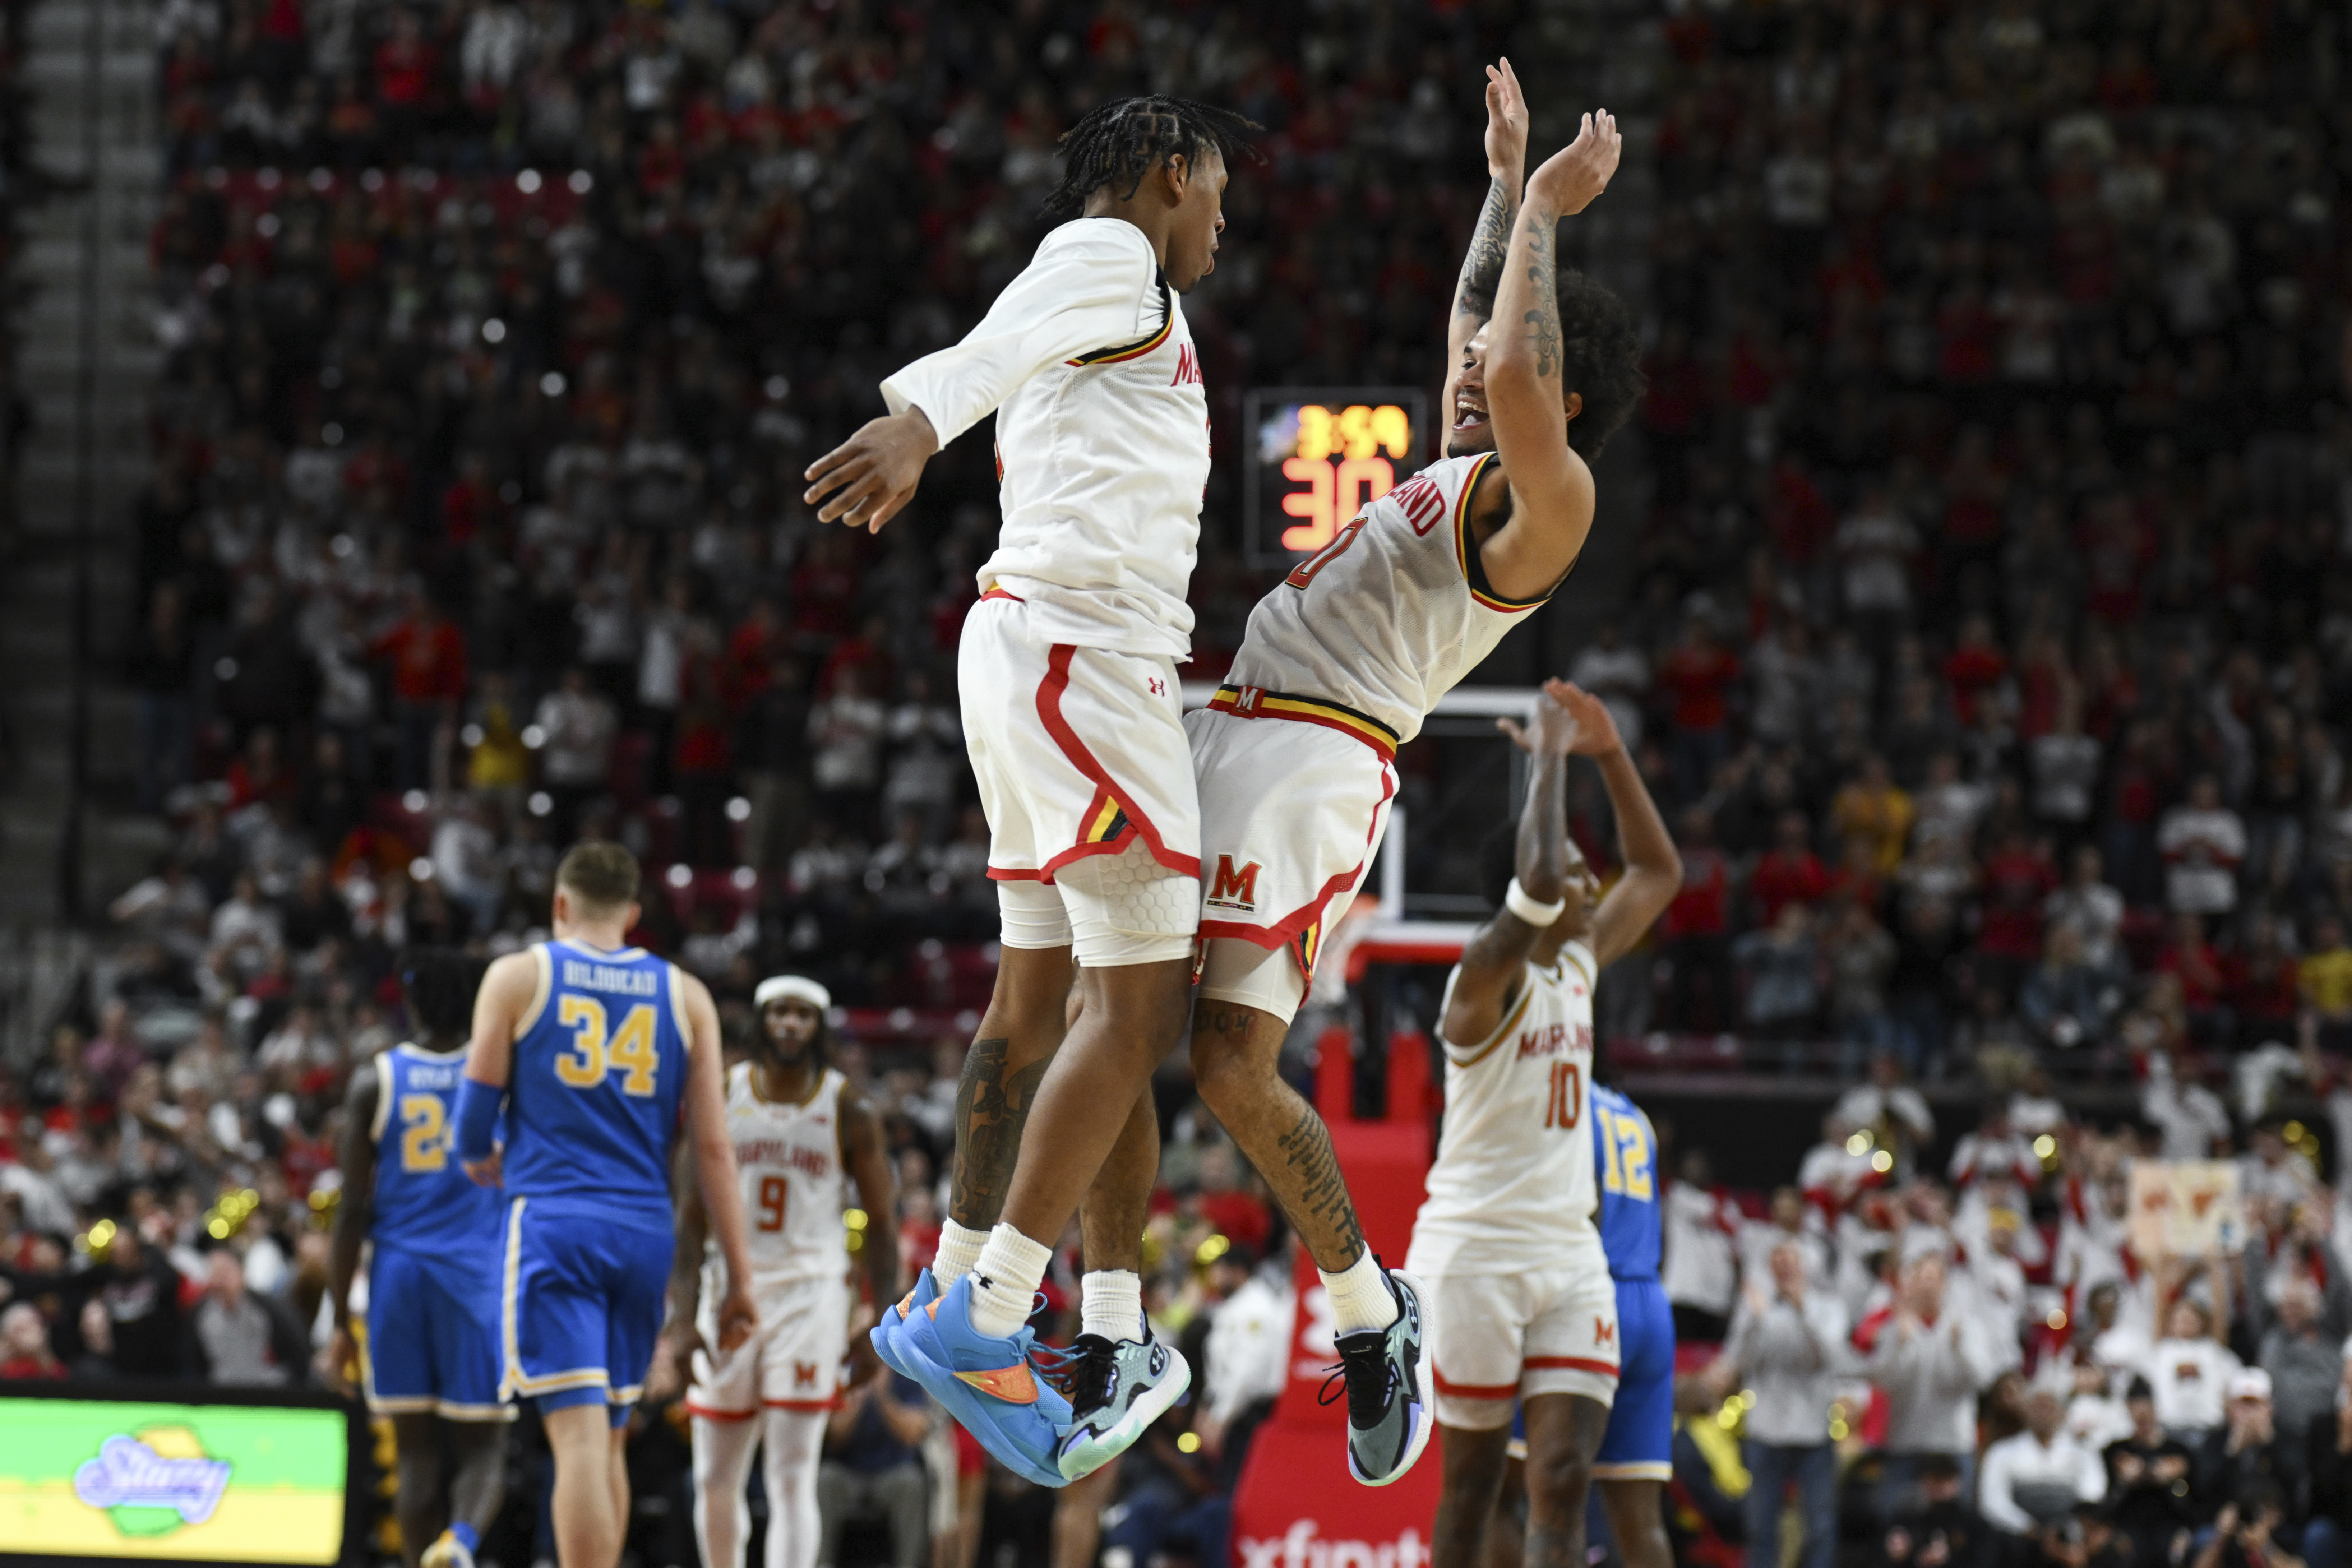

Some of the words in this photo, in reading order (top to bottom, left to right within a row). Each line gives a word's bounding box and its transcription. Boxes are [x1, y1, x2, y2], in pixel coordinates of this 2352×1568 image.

[1297, 405, 1408, 461] 3:59
[1281, 457, 1394, 551] 30
[1285, 516, 1369, 591] 0
[1235, 686, 1258, 711] M
[1209, 855, 1262, 905] M
[554, 991, 660, 1098] 34
[1546, 1060, 1581, 1130] 10
[399, 1093, 456, 1172] 2
[1596, 1106, 1653, 1202] 12
[757, 1174, 789, 1233] 9
